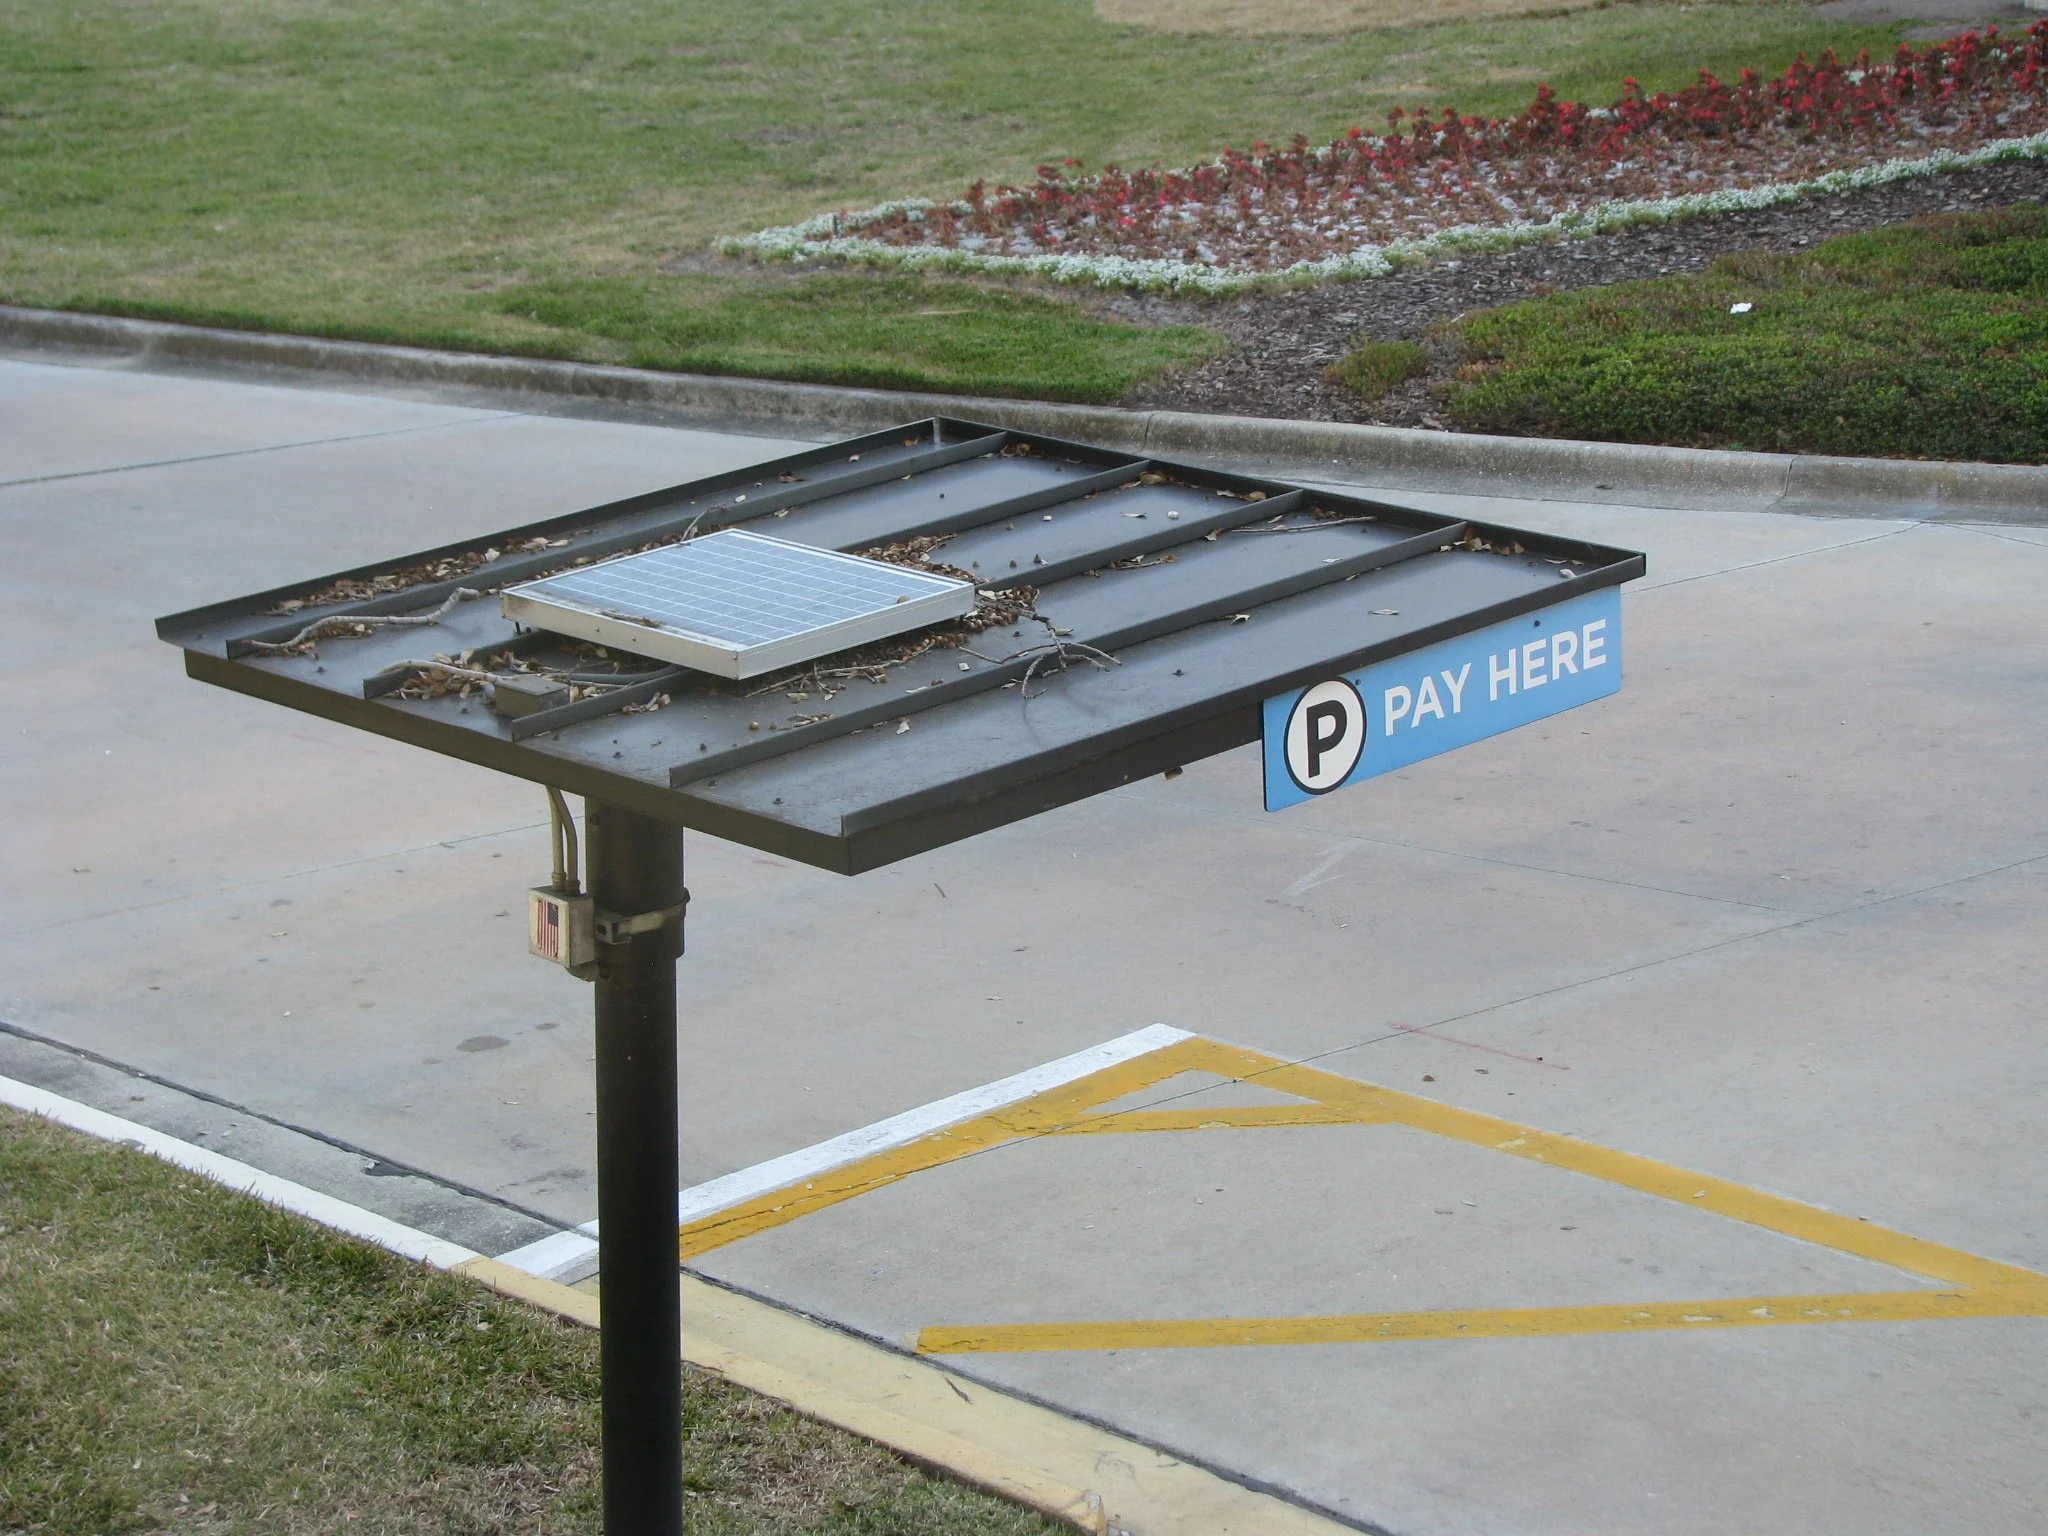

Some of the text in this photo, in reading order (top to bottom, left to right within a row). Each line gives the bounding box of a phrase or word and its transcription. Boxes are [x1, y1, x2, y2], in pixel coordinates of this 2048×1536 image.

[1306, 618, 1607, 778] P PAY HERE
